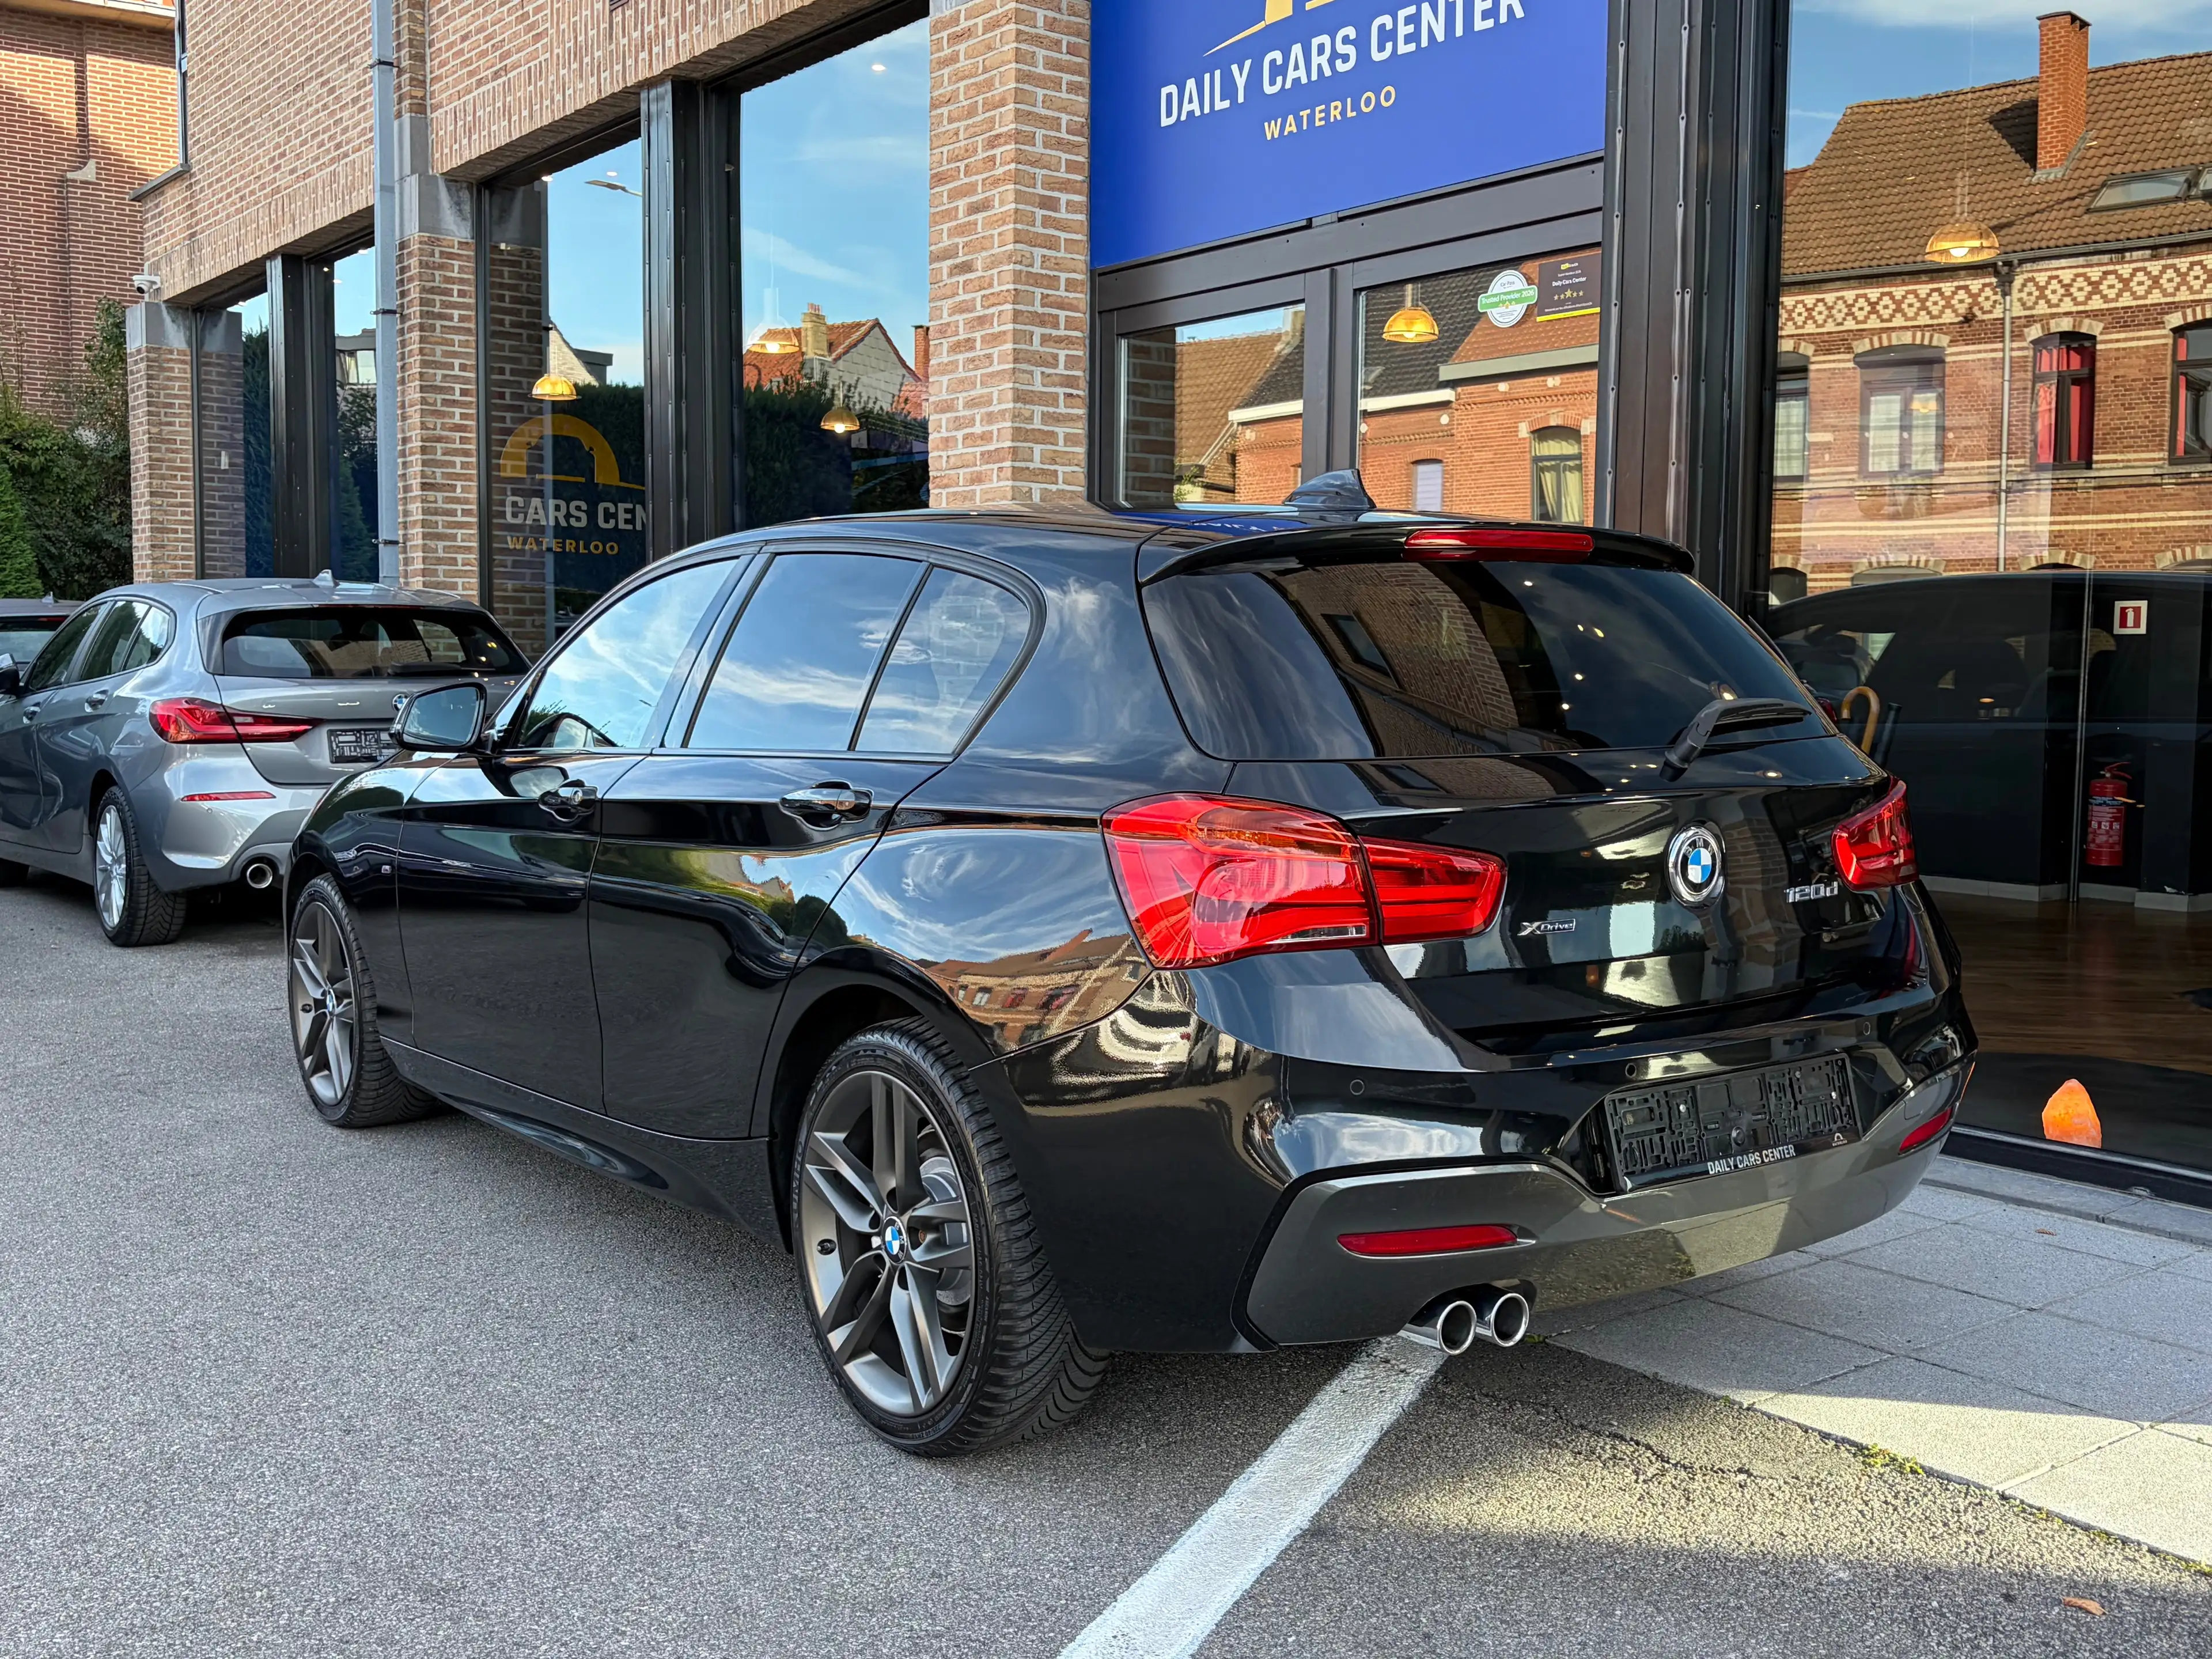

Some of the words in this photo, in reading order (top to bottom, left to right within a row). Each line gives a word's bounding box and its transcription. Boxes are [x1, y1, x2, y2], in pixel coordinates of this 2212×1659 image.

[1159, 58, 1252, 128] DAILY
[1262, 25, 1358, 95] CARS
[1263, 85, 1397, 141] WATERLOO
[1481, 294, 1499, 304] Trusted
[1500, 292, 1521, 301] Provider
[1521, 289, 1535, 298] 2026
[505, 496, 588, 528] CARS
[507, 536, 619, 555] WATERLOO
[1785, 881, 1838, 903] 120d
[1707, 1156, 1734, 1175] DAILY
[1736, 1151, 1762, 1169] CARS
[1762, 1145, 1796, 1164] CENTER
